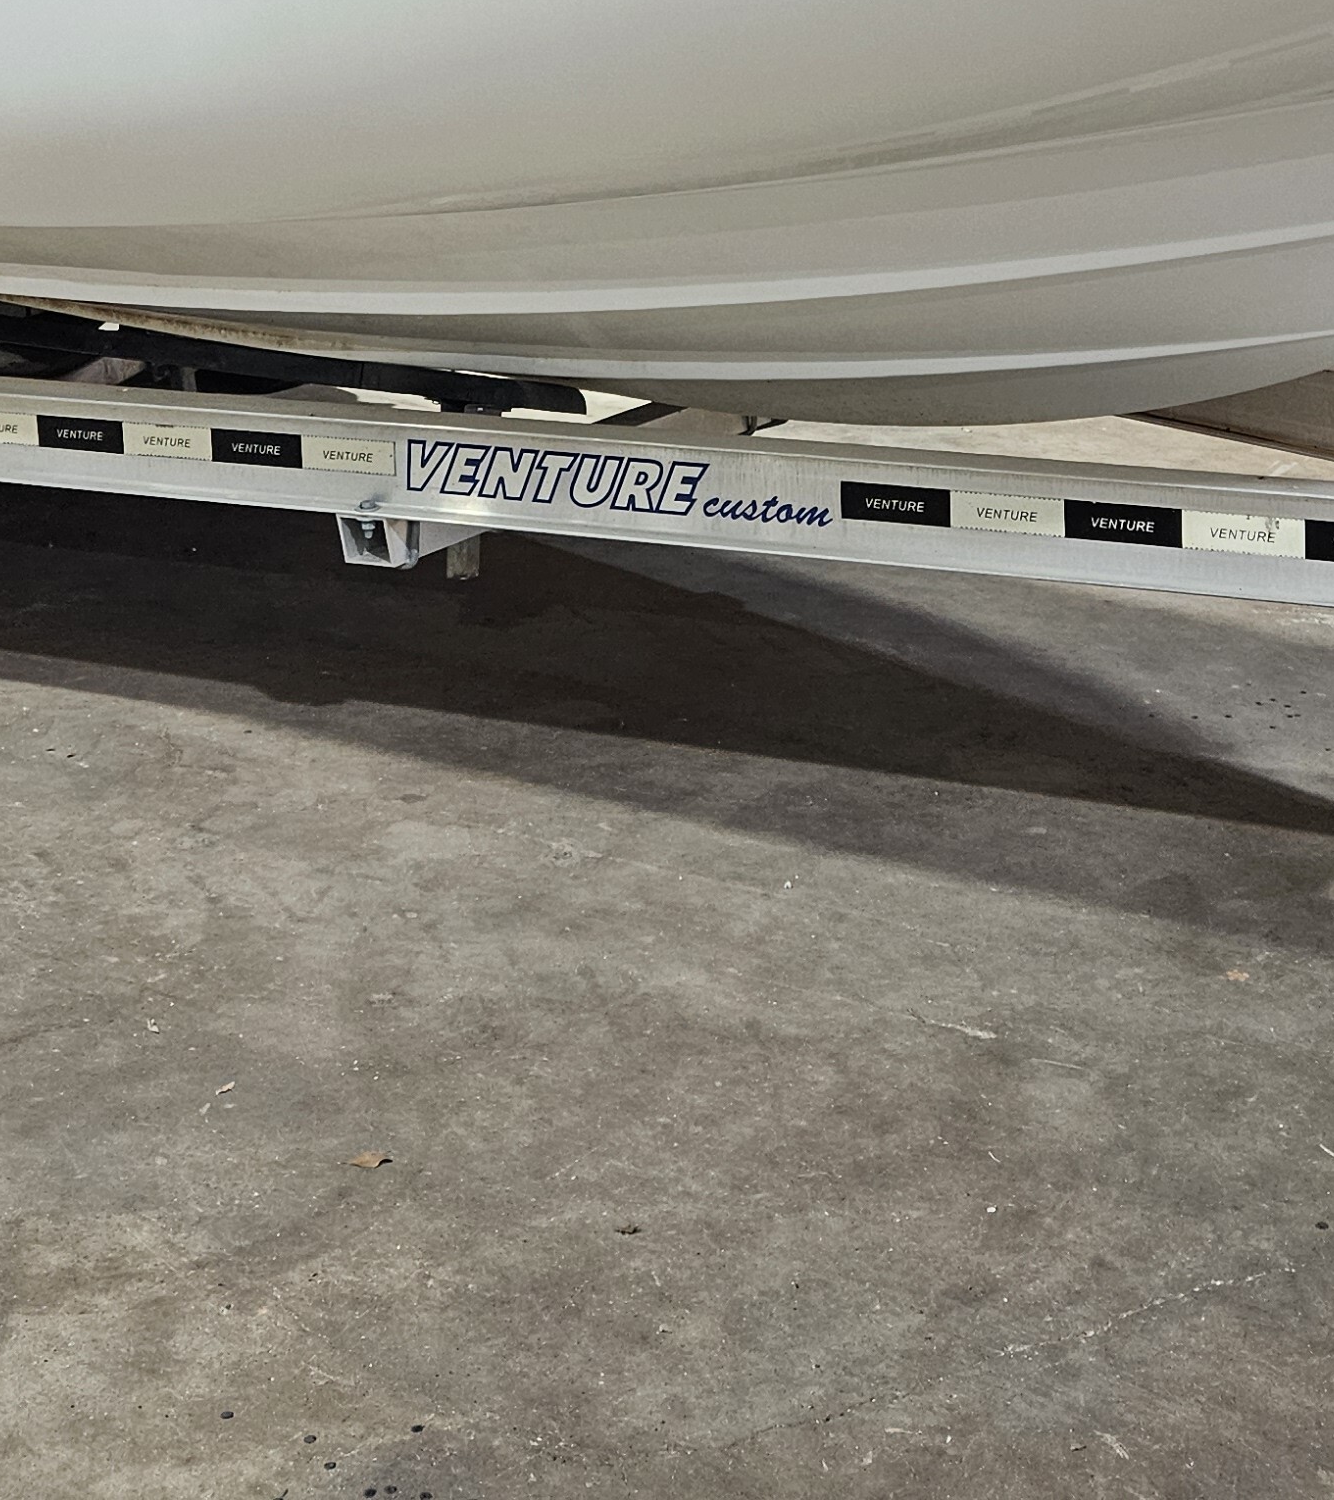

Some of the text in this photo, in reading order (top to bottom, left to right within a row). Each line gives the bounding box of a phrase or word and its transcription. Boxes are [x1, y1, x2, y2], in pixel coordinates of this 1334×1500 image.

[56, 427, 104, 441] VENTURE
[142, 434, 192, 449] VENTURE
[231, 442, 282, 456] VENTURE
[322, 449, 374, 463] VENTURE
[407, 439, 834, 528] VENTURE custom
[865, 497, 925, 513] VENTURE
[976, 507, 1038, 523] VENTURE
[1091, 517, 1155, 533] VENTURE
[1209, 527, 1276, 544] VENTURE
